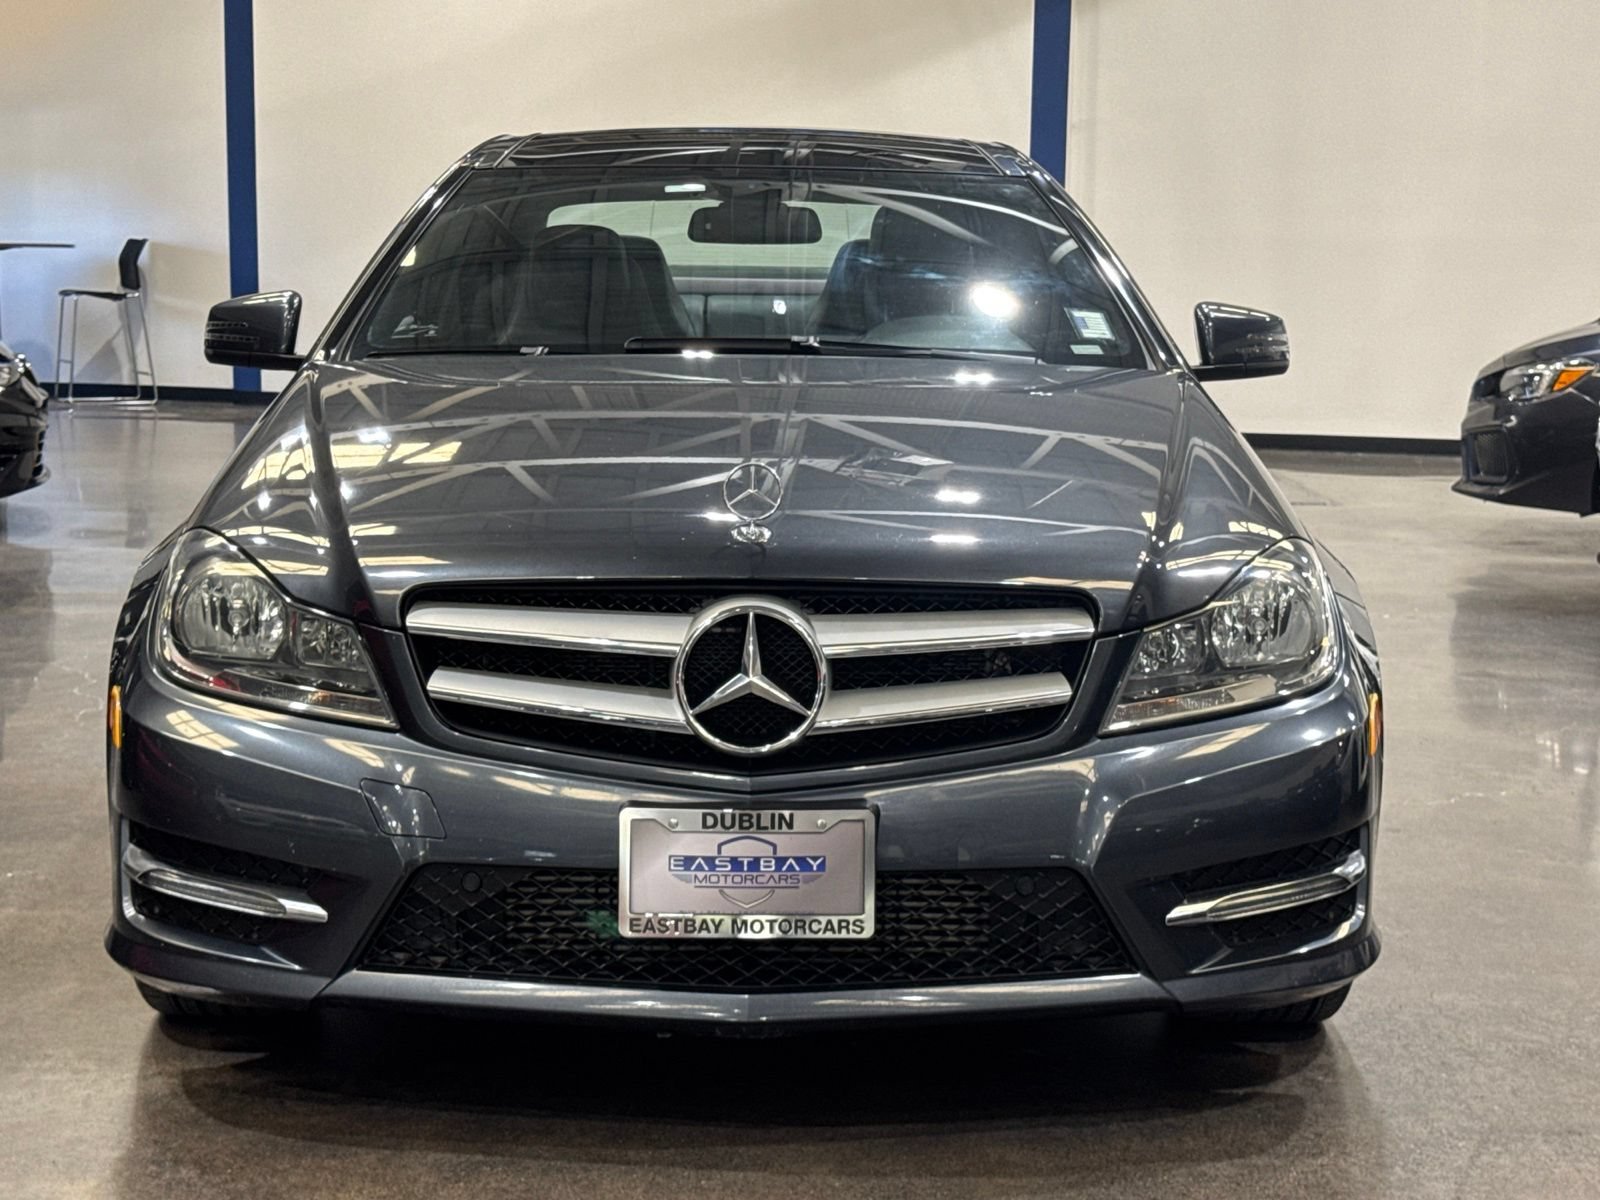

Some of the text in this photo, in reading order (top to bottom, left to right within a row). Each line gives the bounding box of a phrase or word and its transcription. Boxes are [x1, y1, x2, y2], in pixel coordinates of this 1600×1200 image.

[701, 812, 794, 830] DUBLIN
[670, 856, 825, 871] EASTBAY
[693, 874, 800, 885] MOTORCARS
[629, 918, 865, 935] EASTBAY MOTORCARS
